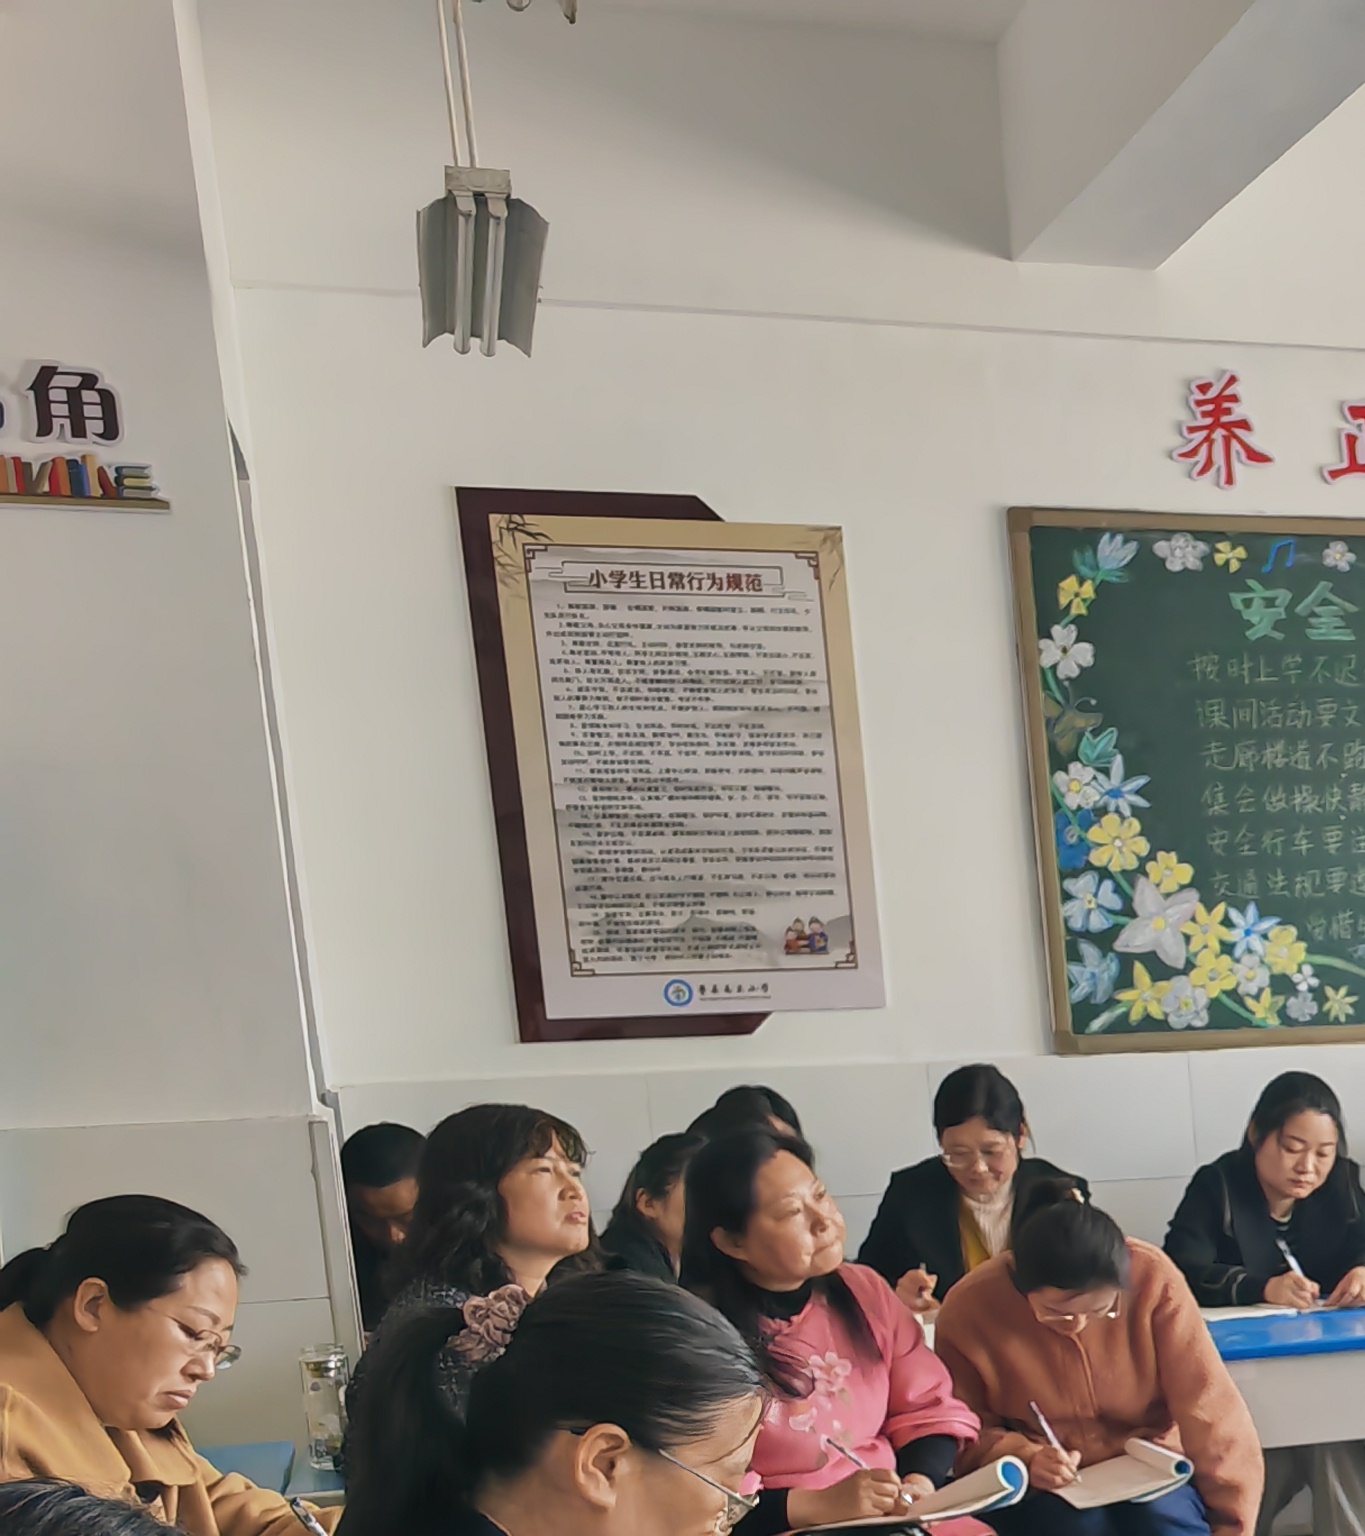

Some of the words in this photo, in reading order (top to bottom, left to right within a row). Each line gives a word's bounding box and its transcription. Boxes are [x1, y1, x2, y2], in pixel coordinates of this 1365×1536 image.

[0, 365, 119, 441] 角
[587, 569, 764, 593] 小学生日常行为规范
